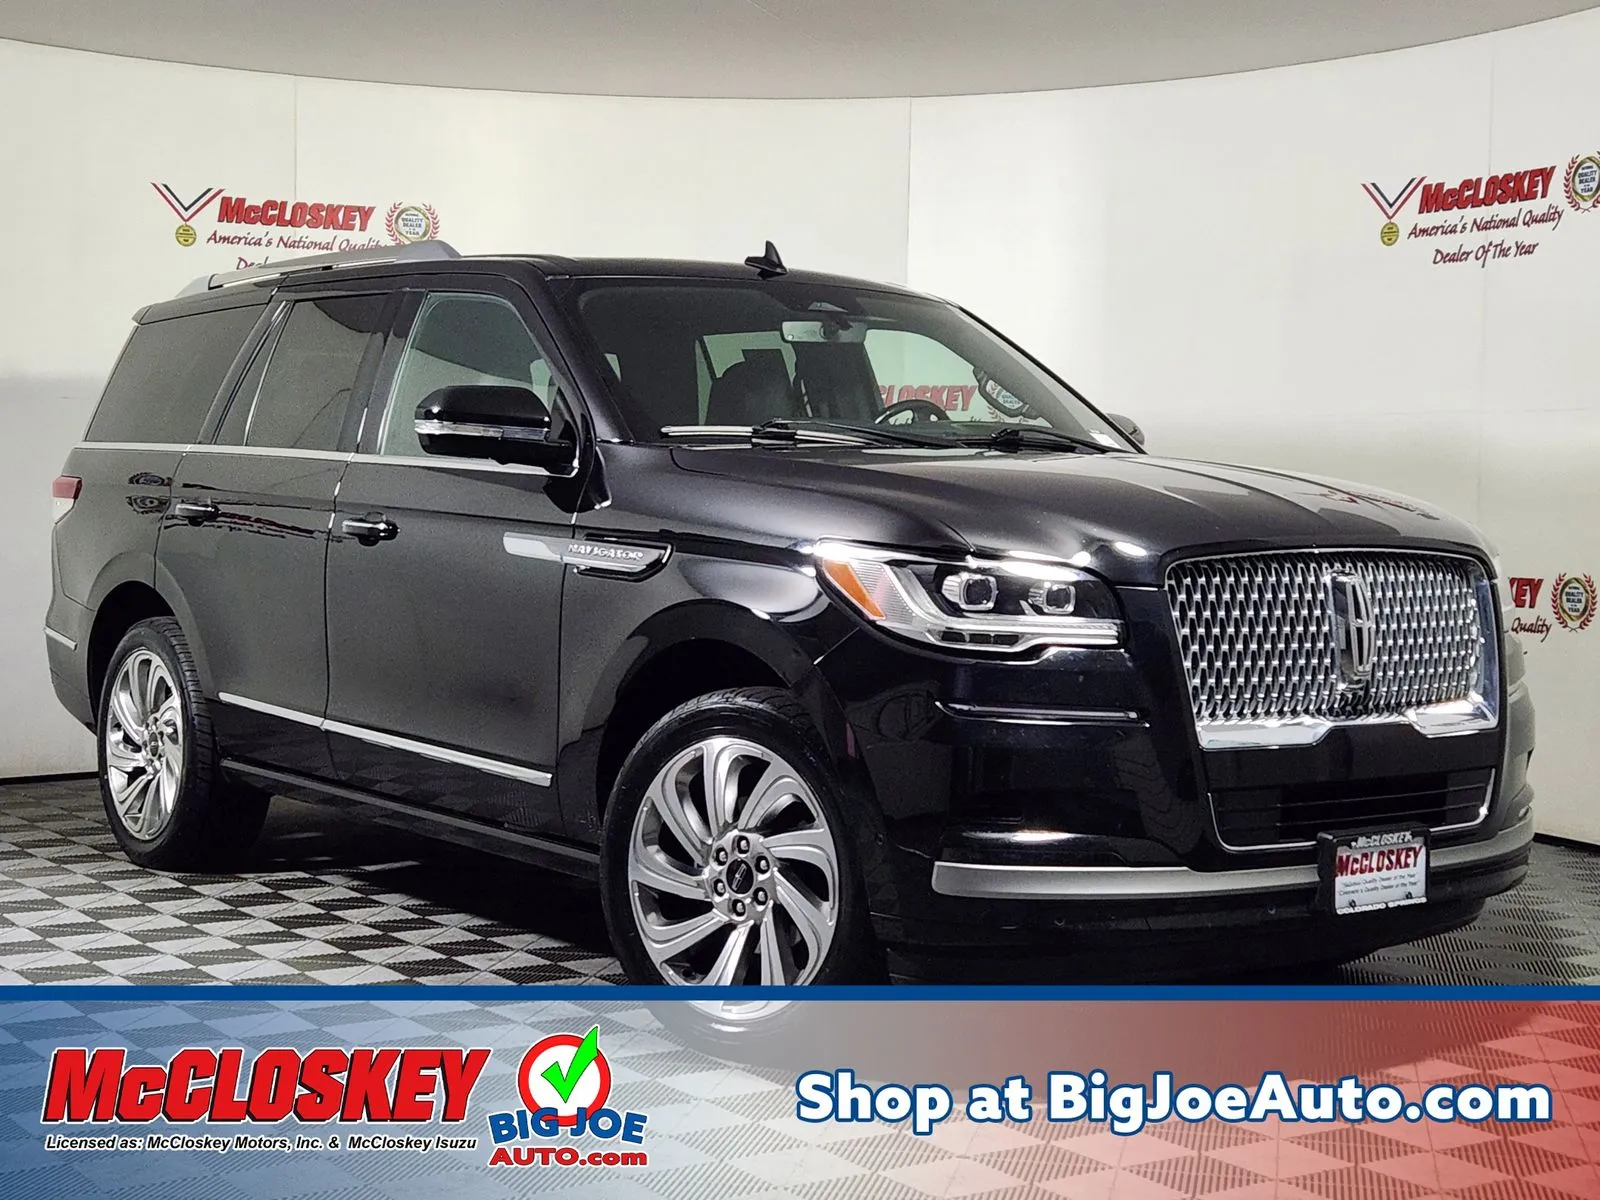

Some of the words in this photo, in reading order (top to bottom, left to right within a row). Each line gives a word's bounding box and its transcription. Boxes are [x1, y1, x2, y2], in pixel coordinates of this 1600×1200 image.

[1418, 166, 1557, 214] McCLOSKEY
[218, 196, 376, 232] McCLOSKEY
[1407, 216, 1467, 239] America's
[1470, 208, 1519, 232] National
[1522, 204, 1564, 231] Quality
[206, 230, 273, 248] America's
[276, 236, 335, 251] National
[338, 239, 388, 252] Qualit
[1432, 244, 1473, 265] Dealer
[1475, 241, 1492, 268] Of
[1493, 240, 1512, 259] The
[1514, 240, 1539, 257] Year
[568, 544, 643, 560] NAVIGATOR
[1511, 615, 1552, 643] Quality
[1336, 845, 1423, 877] McCLOSKEY
[1336, 902, 1386, 915] COLORADO
